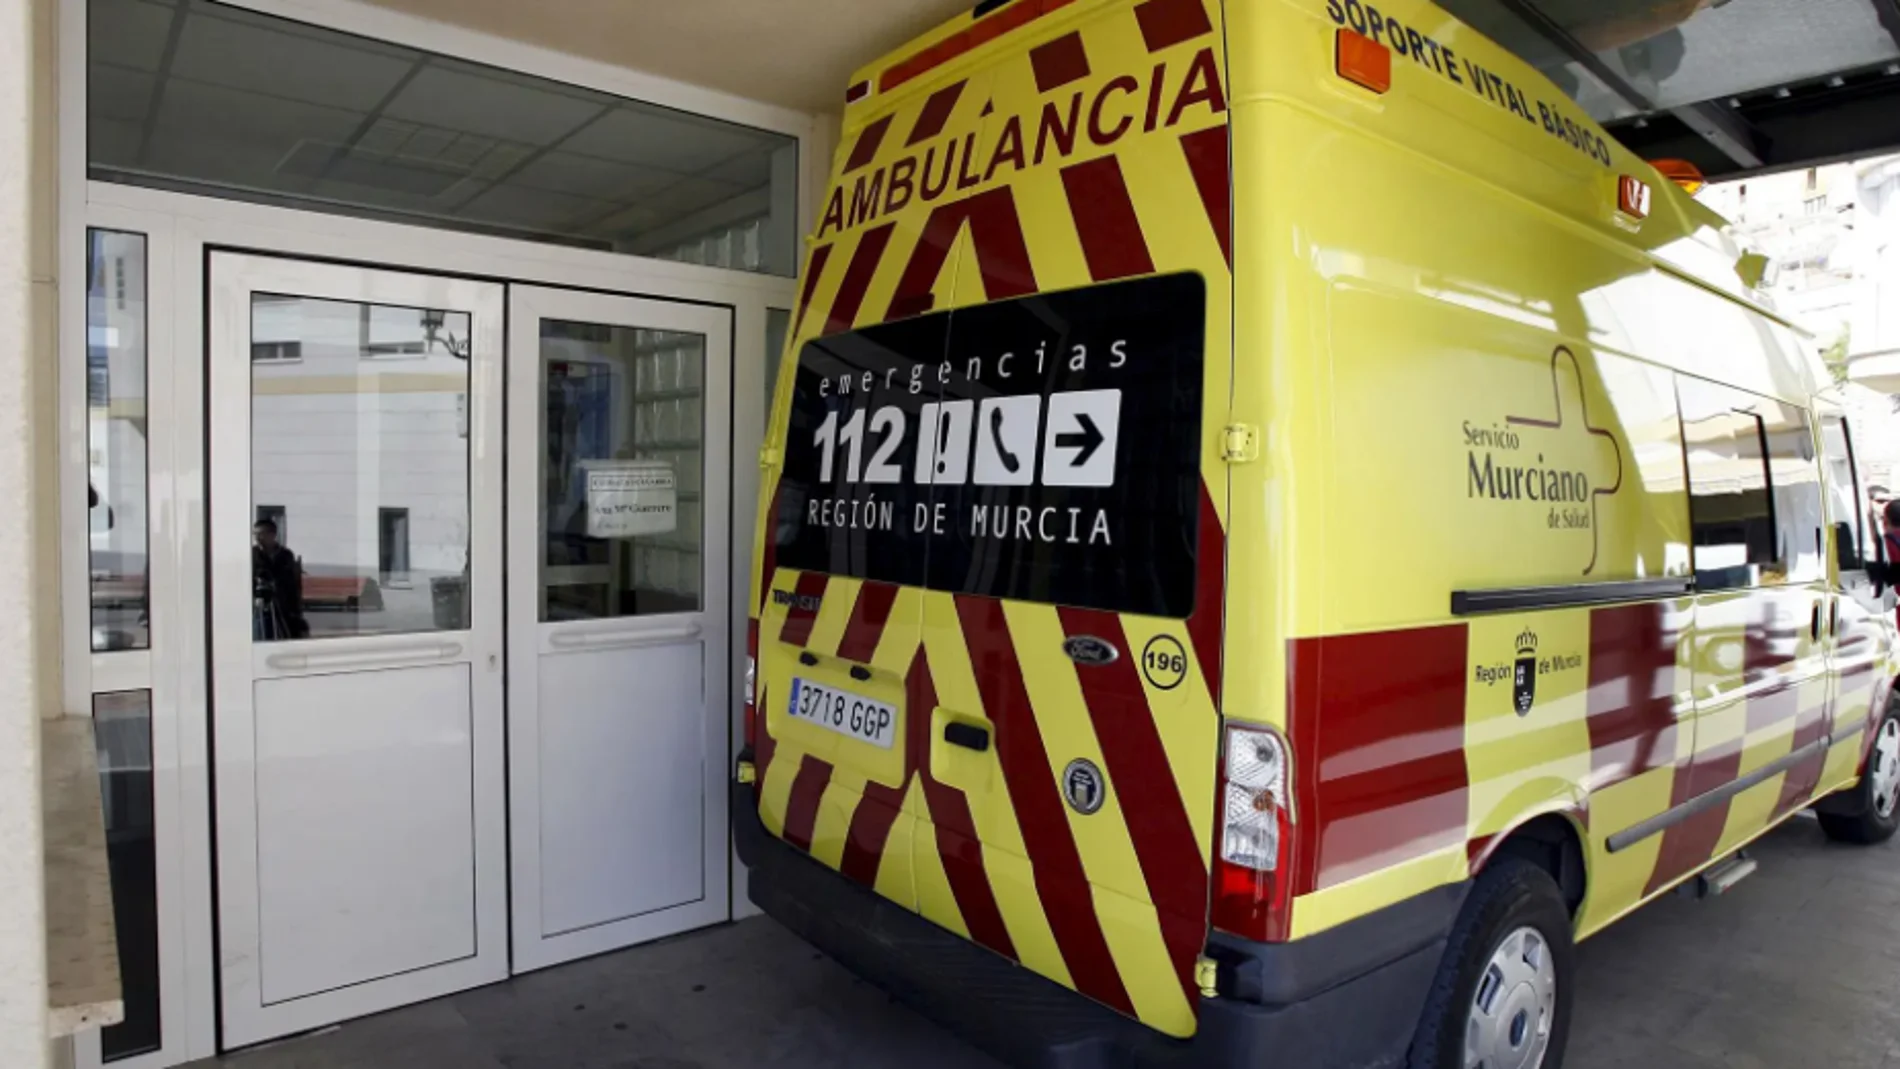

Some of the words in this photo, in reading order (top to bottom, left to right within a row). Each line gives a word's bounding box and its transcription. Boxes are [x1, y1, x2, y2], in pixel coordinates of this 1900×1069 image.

[1327, 0, 1463, 84] SOPORTE
[1463, 57, 1537, 125] VITAL
[1537, 100, 1612, 167] BÁSICO
[816, 46, 1227, 239] AMBULANCIA
[818, 339, 1127, 398] emergencias
[813, 406, 906, 483] 112
[1462, 419, 1520, 450] Servicio
[1467, 450, 1588, 502] Murciano
[807, 493, 894, 531] REGIÓN
[913, 502, 947, 534] DE
[970, 504, 1112, 546] MURCIA
[1547, 507, 1560, 528] de
[1562, 507, 1590, 528] Salud
[1147, 651, 1183, 673] 196
[1475, 661, 1511, 686] Región
[800, 685, 845, 726] 3718
[850, 701, 890, 740] GGP
